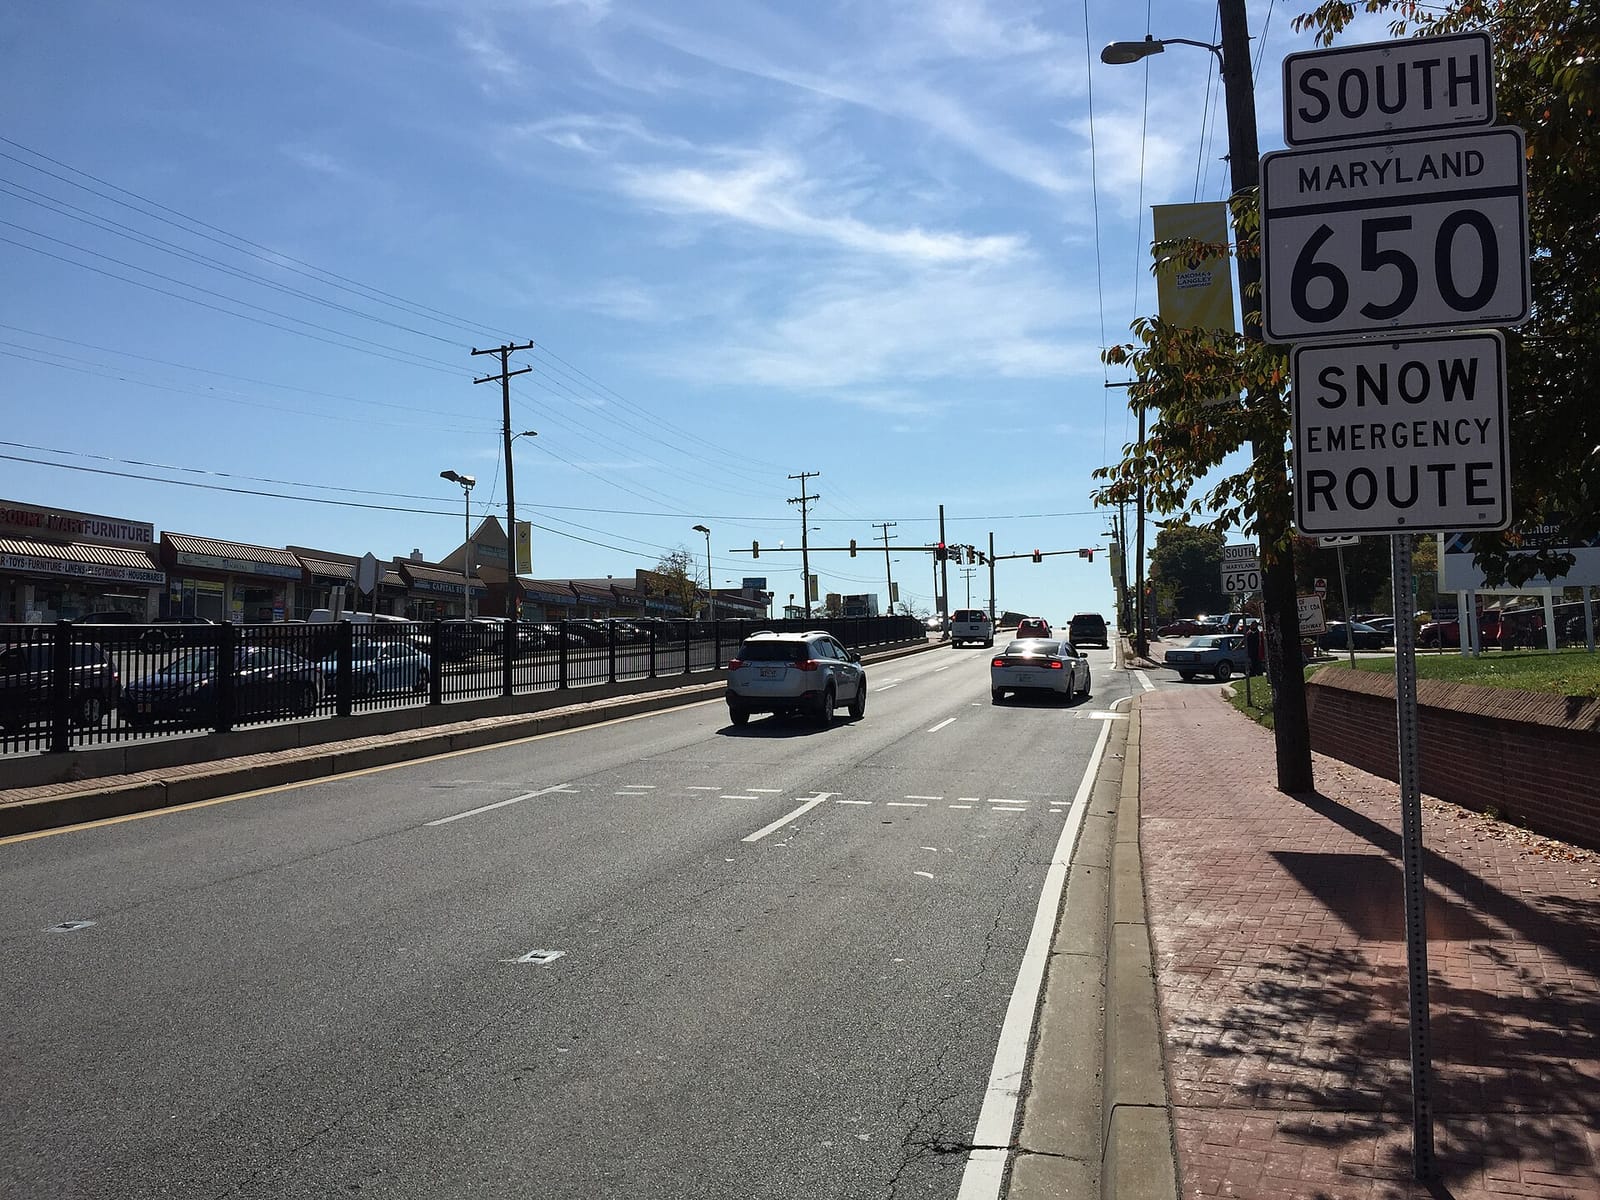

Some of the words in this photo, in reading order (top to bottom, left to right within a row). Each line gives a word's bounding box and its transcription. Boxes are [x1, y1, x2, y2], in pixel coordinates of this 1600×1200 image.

[1298, 54, 1480, 123] SOUTH
[1298, 150, 1484, 193] MARYLAND
[1290, 209, 1499, 323] 650
[1317, 357, 1478, 409] SNOW
[1308, 418, 1491, 452] EMERGENCY
[1307, 462, 1495, 512] ROUTE
[84, 519, 150, 543] FURNITURE
[1226, 546, 1254, 558] SOUTH
[1226, 562, 1256, 570] MARYLAND
[9, 557, 25, 568] TOYS
[28, 559, 62, 571] FURNITURE
[65, 563, 86, 574] LINENS
[88, 566, 125, 579] ELECTRONICS
[128, 570, 164, 582] HOUSEWARES
[1226, 572, 1258, 591] 650
[432, 583, 455, 593] CAPITAL
